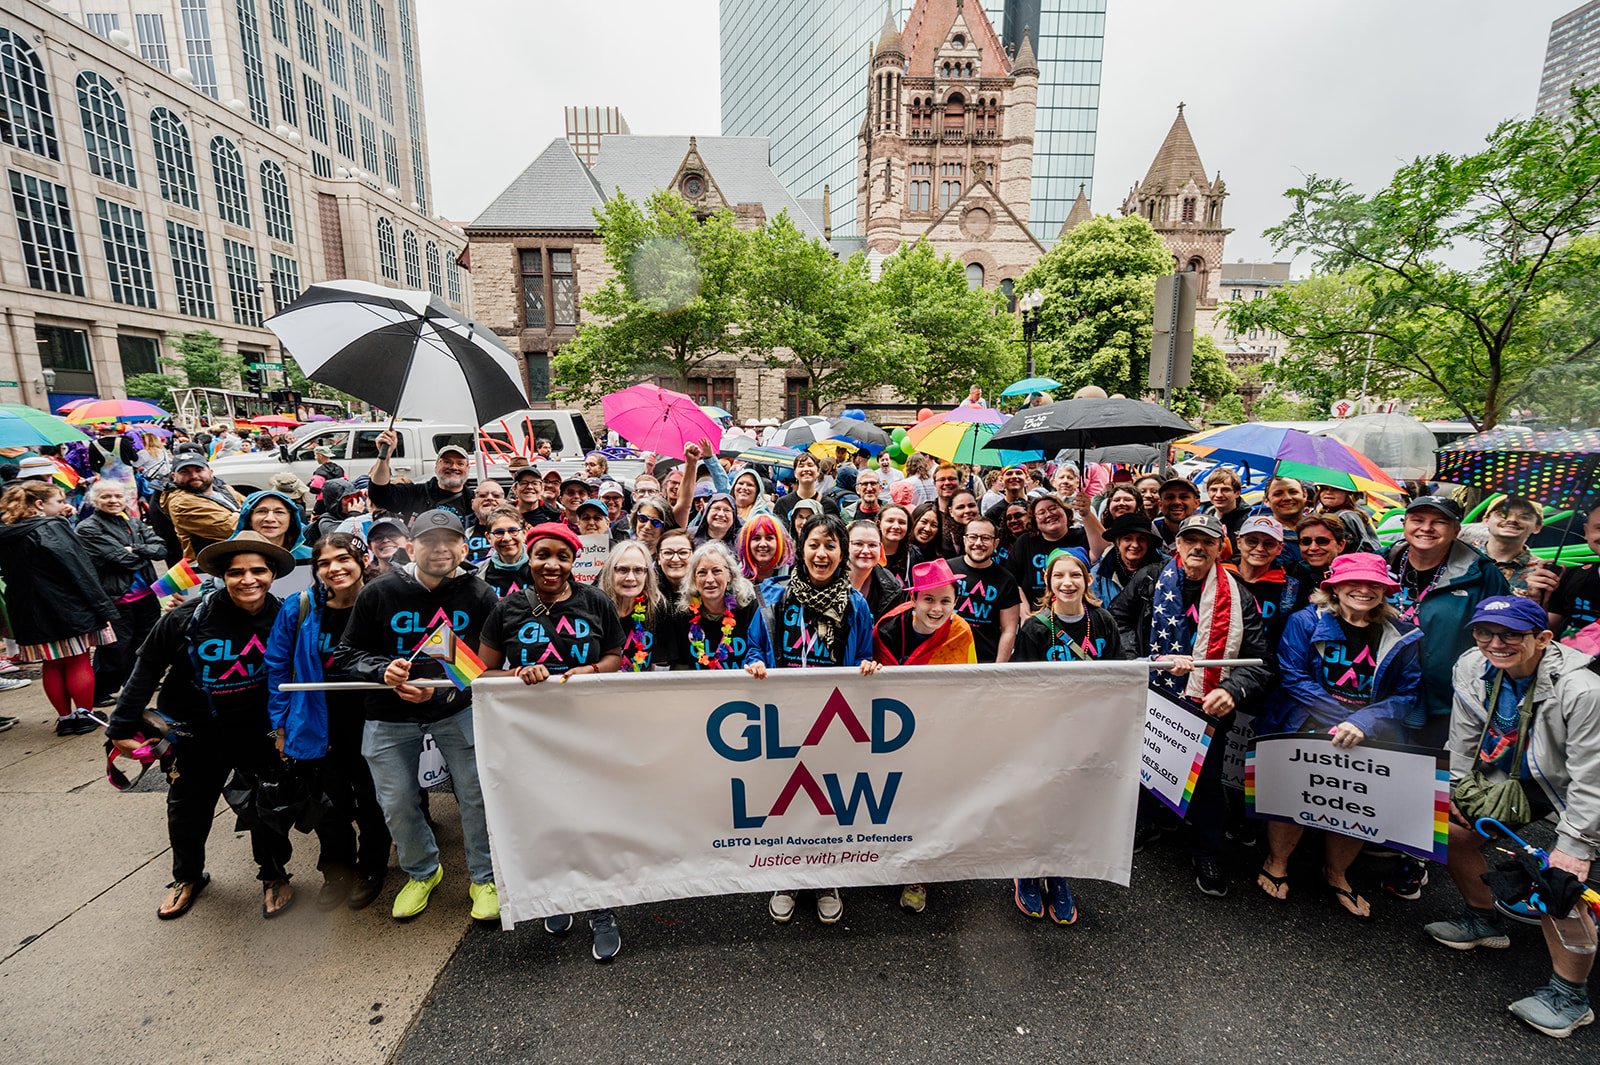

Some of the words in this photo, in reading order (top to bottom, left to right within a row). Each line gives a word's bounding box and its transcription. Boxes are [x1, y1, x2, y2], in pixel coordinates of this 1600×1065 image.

[390, 607, 470, 634] GLAD
[518, 615, 590, 644] GLAD
[198, 633, 270, 661] GLA
[1324, 642, 1379, 666] GLA
[706, 686, 916, 762] GLAD
[1145, 721, 1187, 754] Answers
[1149, 707, 1200, 743] derechos!
[1289, 748, 1391, 777] Justicia
[731, 761, 903, 829] LAW
[1309, 773, 1367, 795] para
[1301, 790, 1376, 818] todes
[1299, 811, 1340, 827] GLAD
[1342, 821, 1379, 837] LAW
[712, 837, 751, 848] GLBTQ
[754, 836, 783, 846] Legal
[786, 834, 843, 845] Advocates
[846, 834, 853, 842] &
[856, 833, 914, 843] Defenders
[749, 853, 801, 868] Justice
[806, 852, 836, 864] with
[841, 851, 879, 863] Pride
